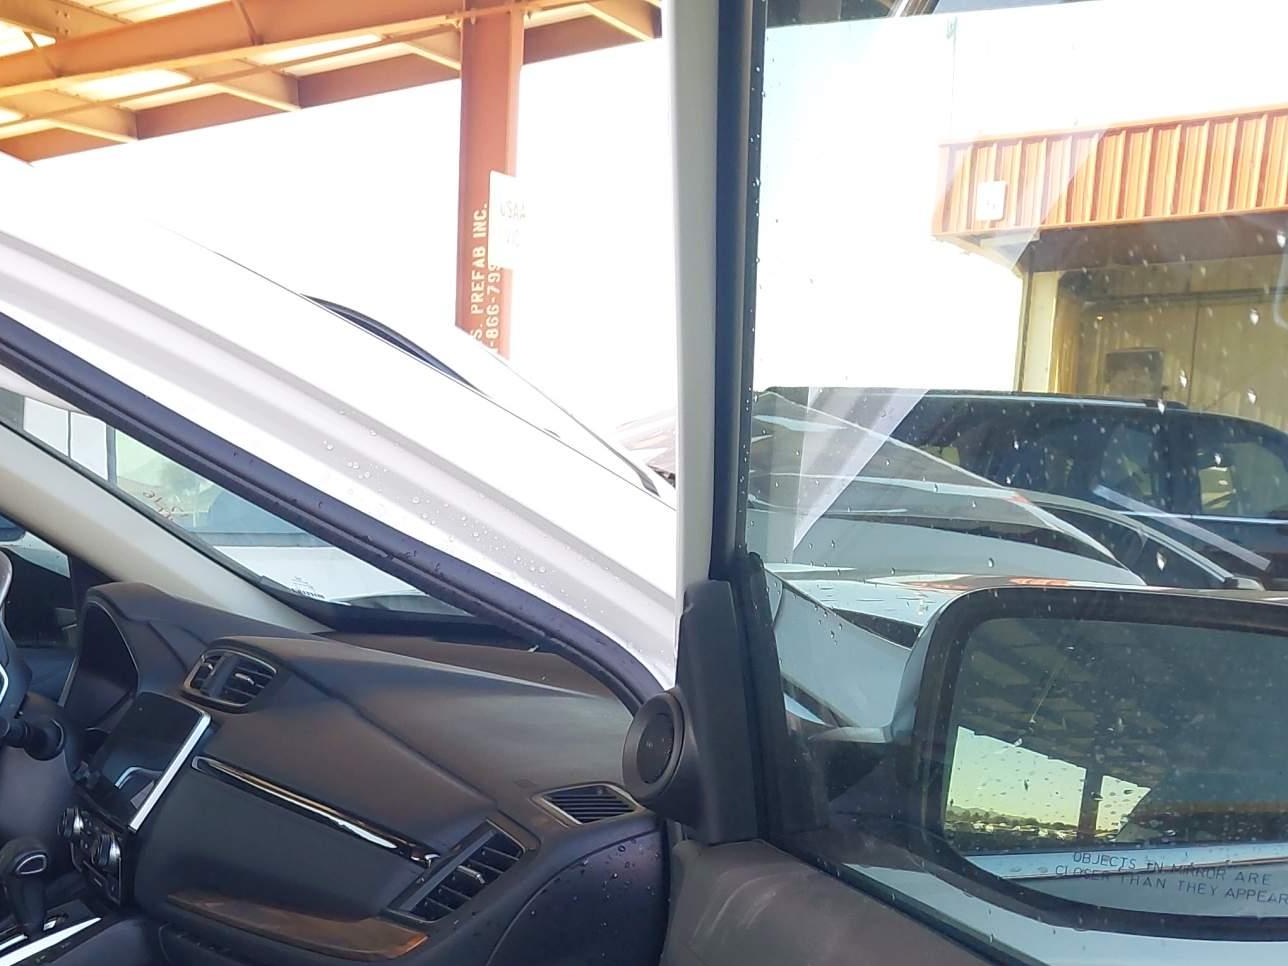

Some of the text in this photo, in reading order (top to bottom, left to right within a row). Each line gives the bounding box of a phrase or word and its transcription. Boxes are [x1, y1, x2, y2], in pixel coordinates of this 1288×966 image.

[473, 204, 488, 238] INC.
[471, 246, 486, 314] PREFAB
[1074, 852, 1136, 870] OBJECTS
[1235, 872, 1272, 886] ARE
[1120, 874, 1167, 888] THAN
[1178, 880, 1218, 896] THEY
